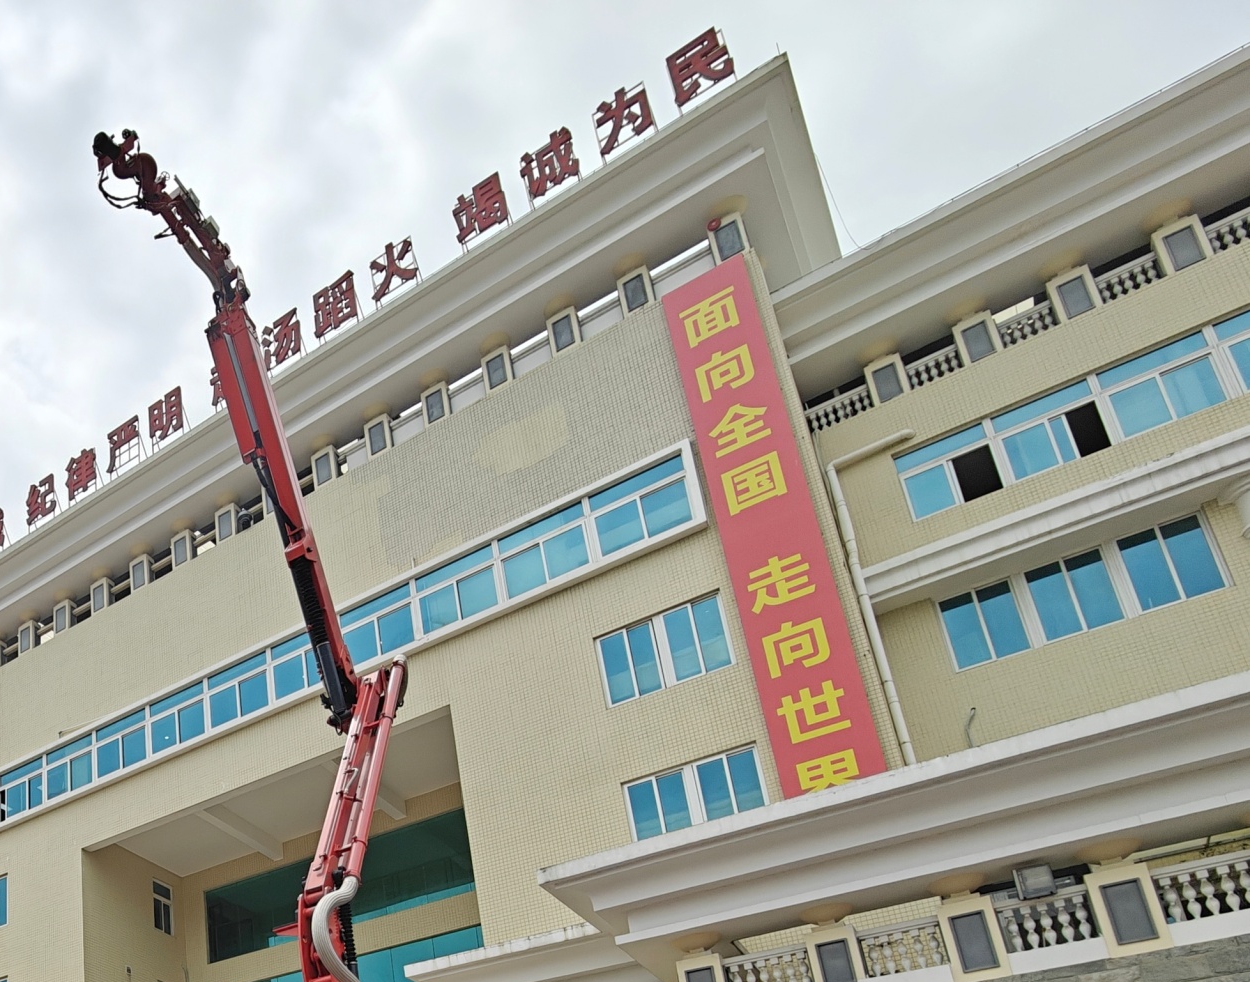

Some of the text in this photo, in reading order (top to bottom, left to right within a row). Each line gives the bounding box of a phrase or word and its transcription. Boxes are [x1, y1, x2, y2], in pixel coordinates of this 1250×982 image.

[26, 386, 183, 525] 纪律严明
[210, 239, 418, 407] 汤蹈火
[452, 26, 734, 243] 竭诚为民
[679, 285, 859, 793] 面向全国 走向世界
